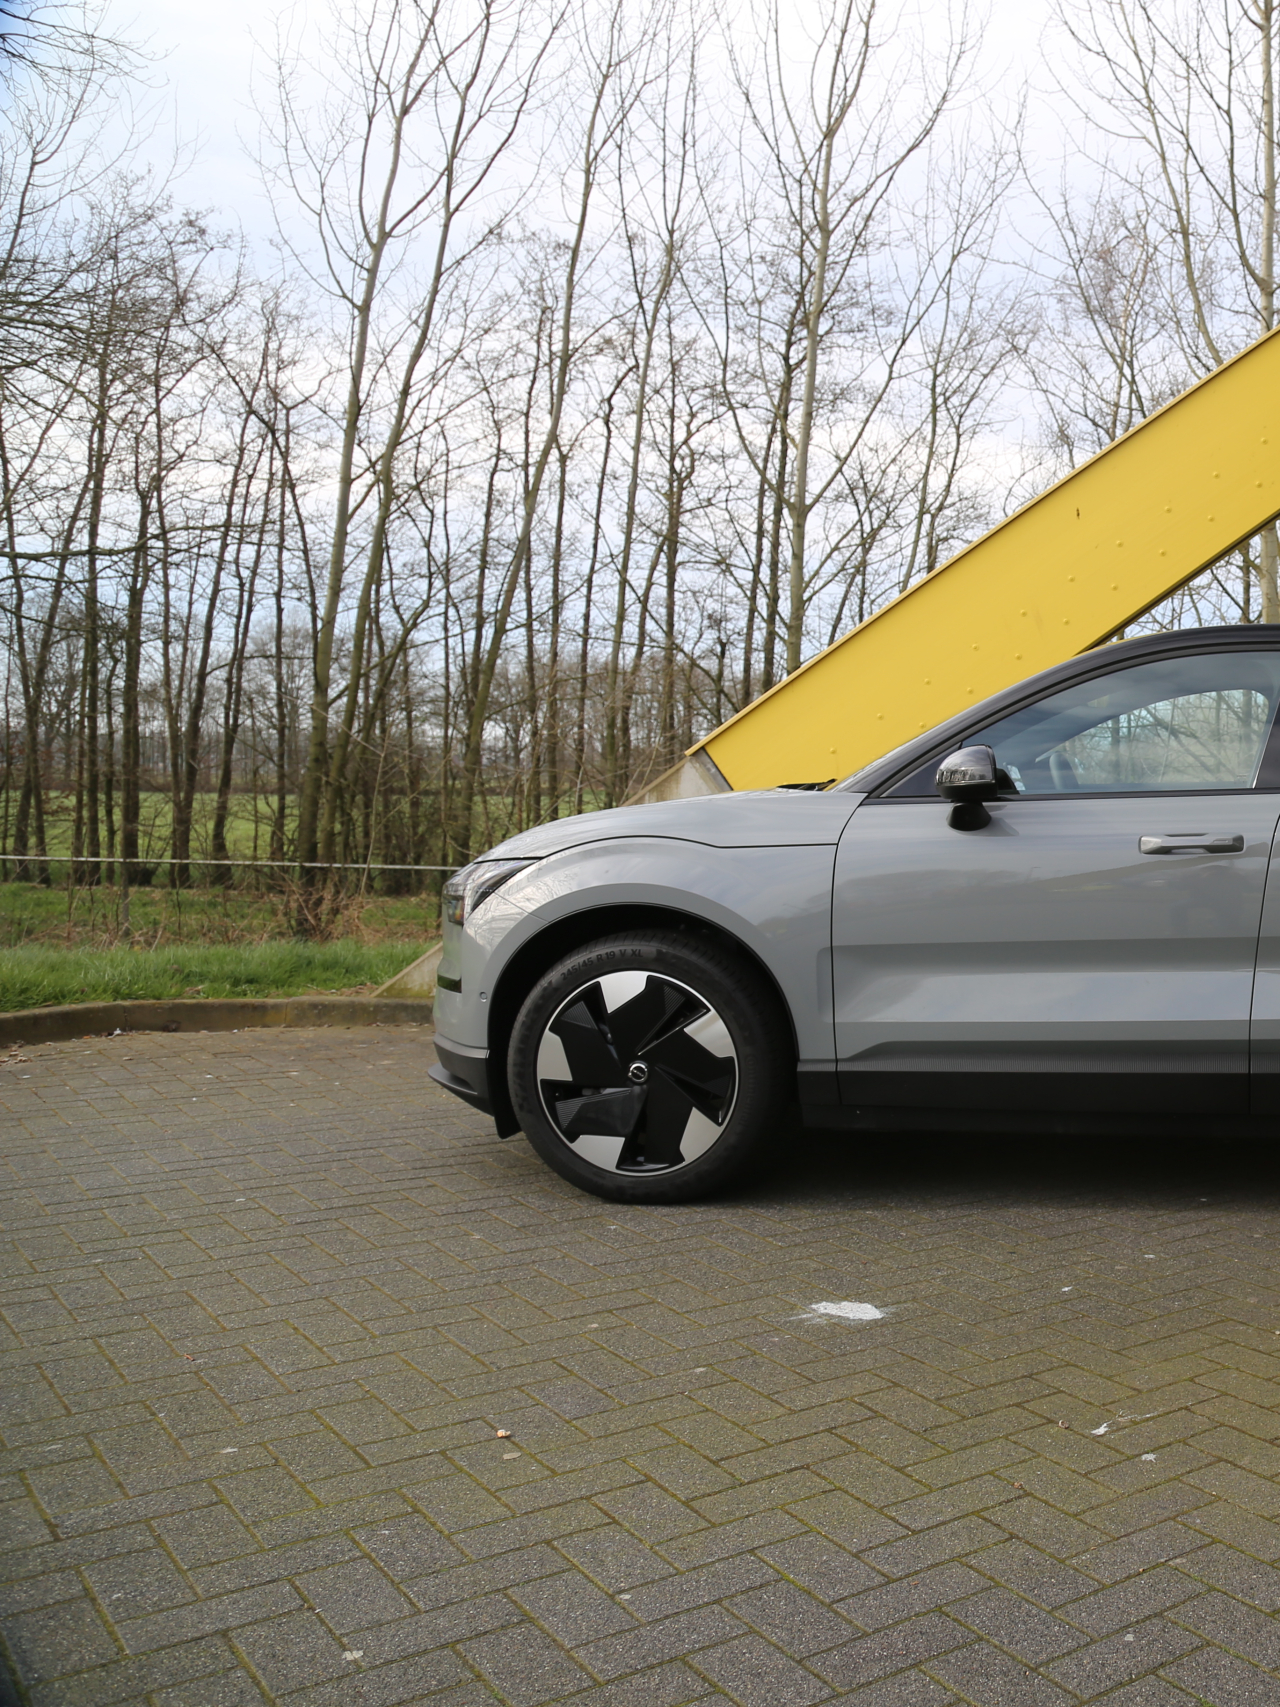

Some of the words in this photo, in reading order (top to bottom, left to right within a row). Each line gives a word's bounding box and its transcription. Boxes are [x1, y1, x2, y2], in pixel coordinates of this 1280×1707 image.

[560, 957, 594, 981] 245/45
[596, 953, 604, 963] R
[605, 950, 616, 961] 19
[631, 948, 643, 958] XL
